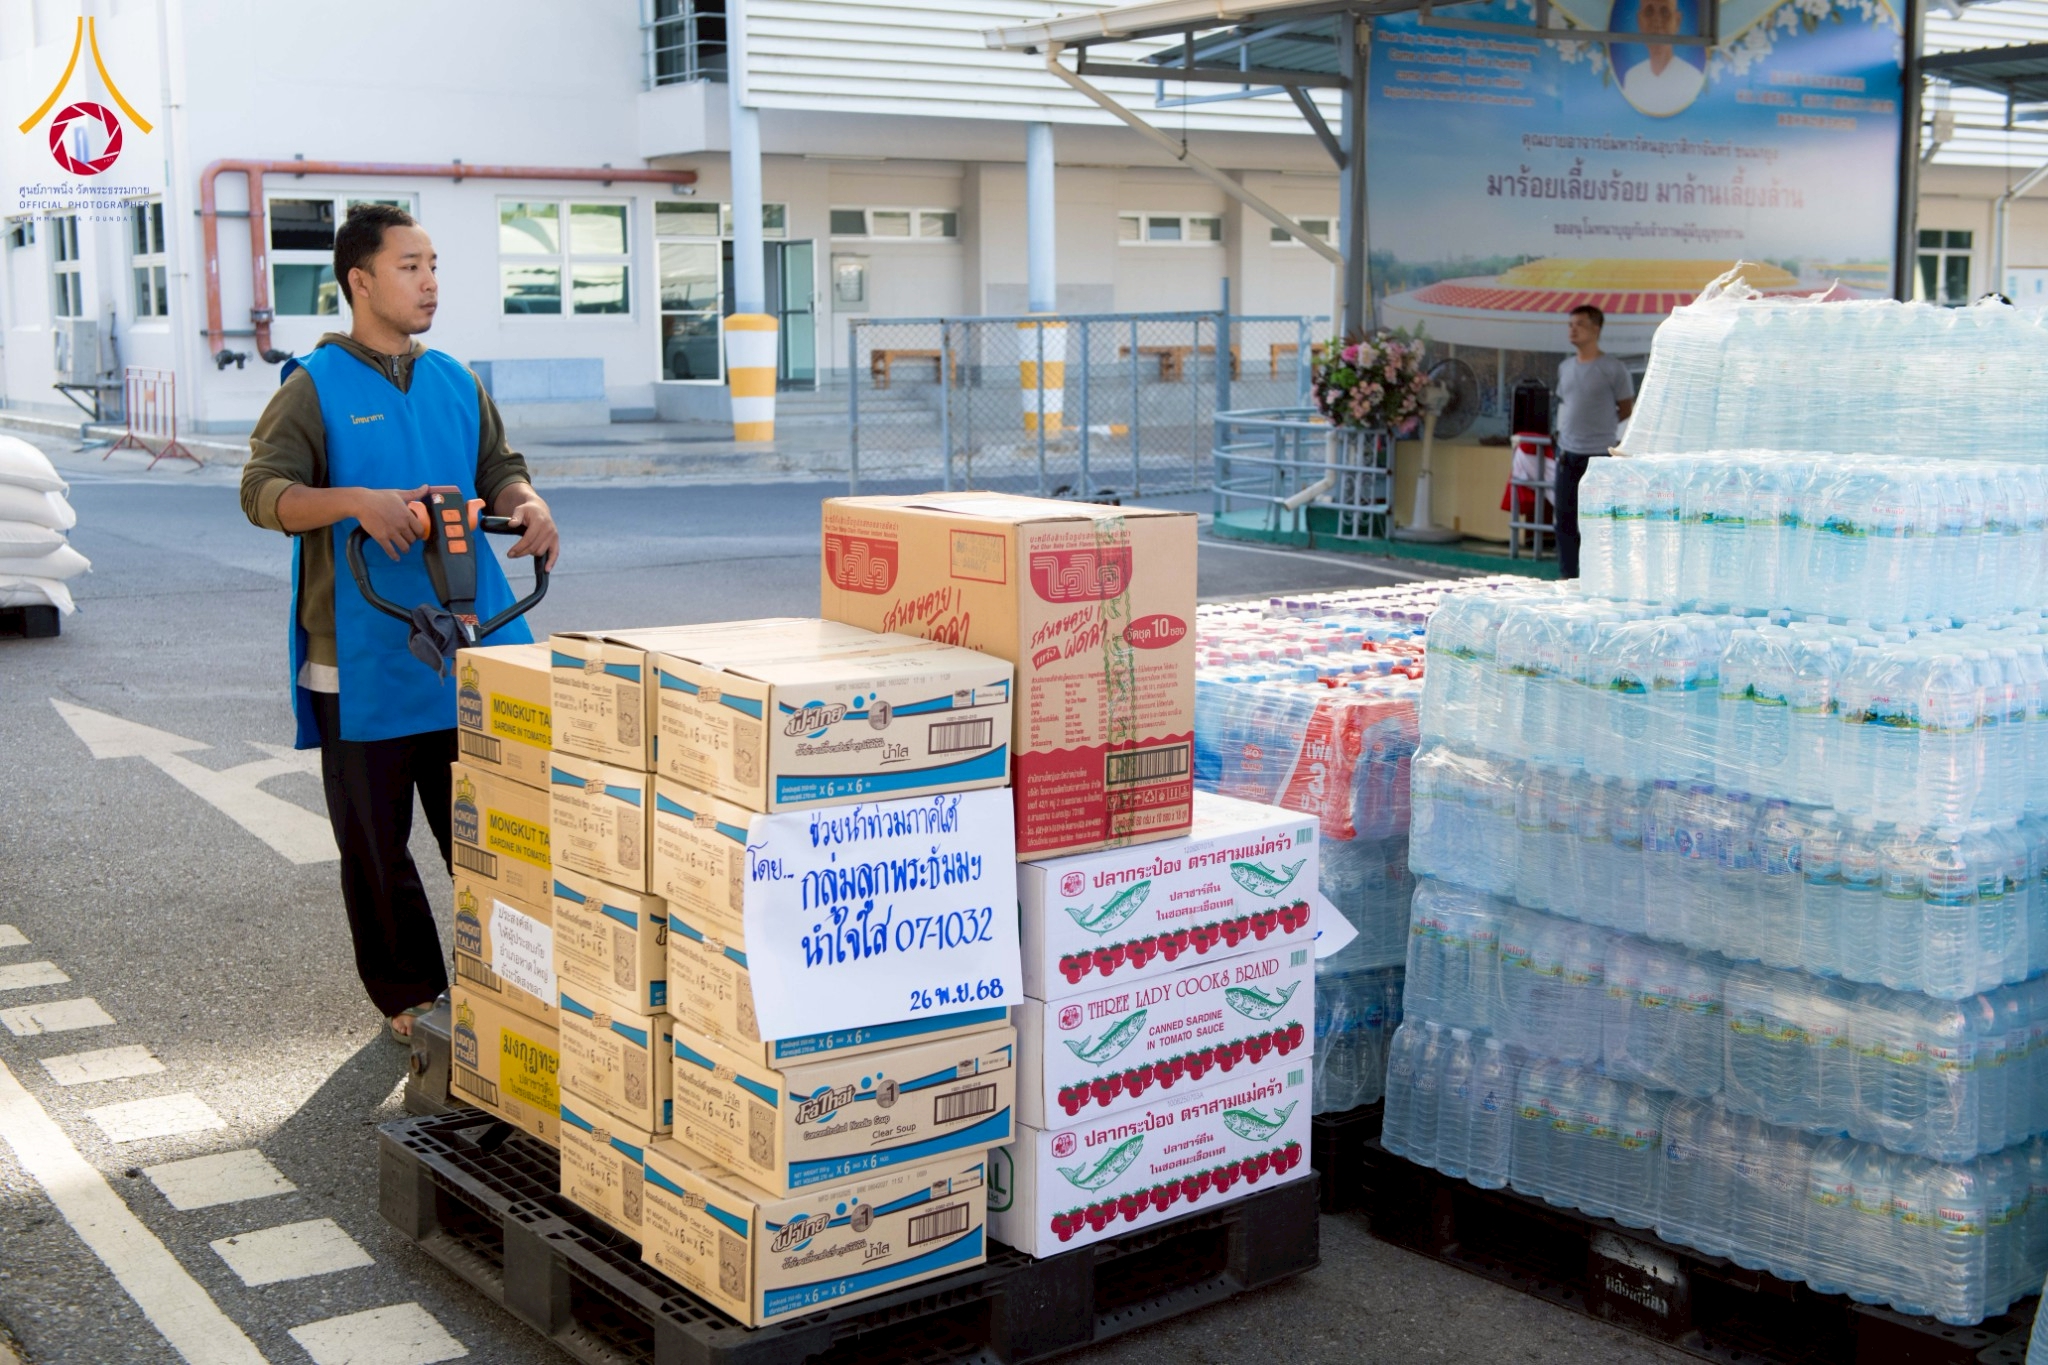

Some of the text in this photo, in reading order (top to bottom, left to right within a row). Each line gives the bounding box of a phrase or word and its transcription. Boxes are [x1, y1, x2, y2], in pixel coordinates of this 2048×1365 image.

[1486, 157, 1805, 208] มาร้อยเลี้ยงร้อย มาล้านเลี้ยงล้าน
[1127, 618, 1184, 643] จัดชุด 10 ซอง
[493, 699, 536, 723] MONGKUT
[790, 705, 842, 734] ฟ้าไทย
[494, 720, 545, 744] SARDINE IN TOMATO
[883, 743, 909, 759] น้ำใส
[827, 781, 834, 797] 6
[856, 778, 863, 793] 6
[1308, 763, 1326, 795] 3
[455, 823, 477, 840] TALAY
[490, 814, 536, 842] MONGKUT
[810, 794, 962, 848] ช่วยน้ำท่วมภาคใต้
[490, 836, 546, 863] SARDINE IN TOMATO
[1093, 856, 1181, 888] ปลากระป๋อง
[1188, 832, 1291, 869] ตราสามแม่ครัว
[1169, 882, 1221, 902] ปลาซาร์ดีน
[499, 907, 533, 934] ประสงค์ส่ง
[1156, 897, 1234, 921] ในซอสมะเขือเทศ
[457, 934, 480, 952] TALAY
[498, 922, 545, 959] ให้ผู้ประสบภัย
[801, 904, 993, 968] น้ำใจใส 07-1032
[500, 944, 549, 983] อำเภอหาดใหญ่
[501, 963, 543, 998] จังหวัดสงขลา
[1088, 958, 1279, 1021] THREE LADY COOKS BRAND
[910, 989, 932, 1011] 26
[1147, 1022, 1225, 1050] IN TOMATO SAUCE
[1149, 1009, 1223, 1036] CANNED SARDINE
[826, 1036, 833, 1049] 6
[855, 1030, 862, 1043] 6
[519, 1073, 553, 1096] ปลาซาร์ดีน
[799, 1085, 855, 1122] FaThai
[1084, 1079, 1283, 1147] ปลากระป๋อง ตราสามแม่ครัว
[804, 1114, 890, 1141] Concentrated Noodle Soup
[872, 1122, 916, 1139] Clear Soup
[1163, 1133, 1214, 1155] ปลาซาร์ดีน
[844, 1161, 850, 1174] 6
[870, 1154, 877, 1168] 6
[1150, 1145, 1226, 1175] ในซอสมะเขือเทศ
[777, 1216, 829, 1249] ฟ้าไทย
[865, 1242, 890, 1259] น้ำใส
[812, 1288, 819, 1302] 6
[839, 1281, 846, 1294] 6
